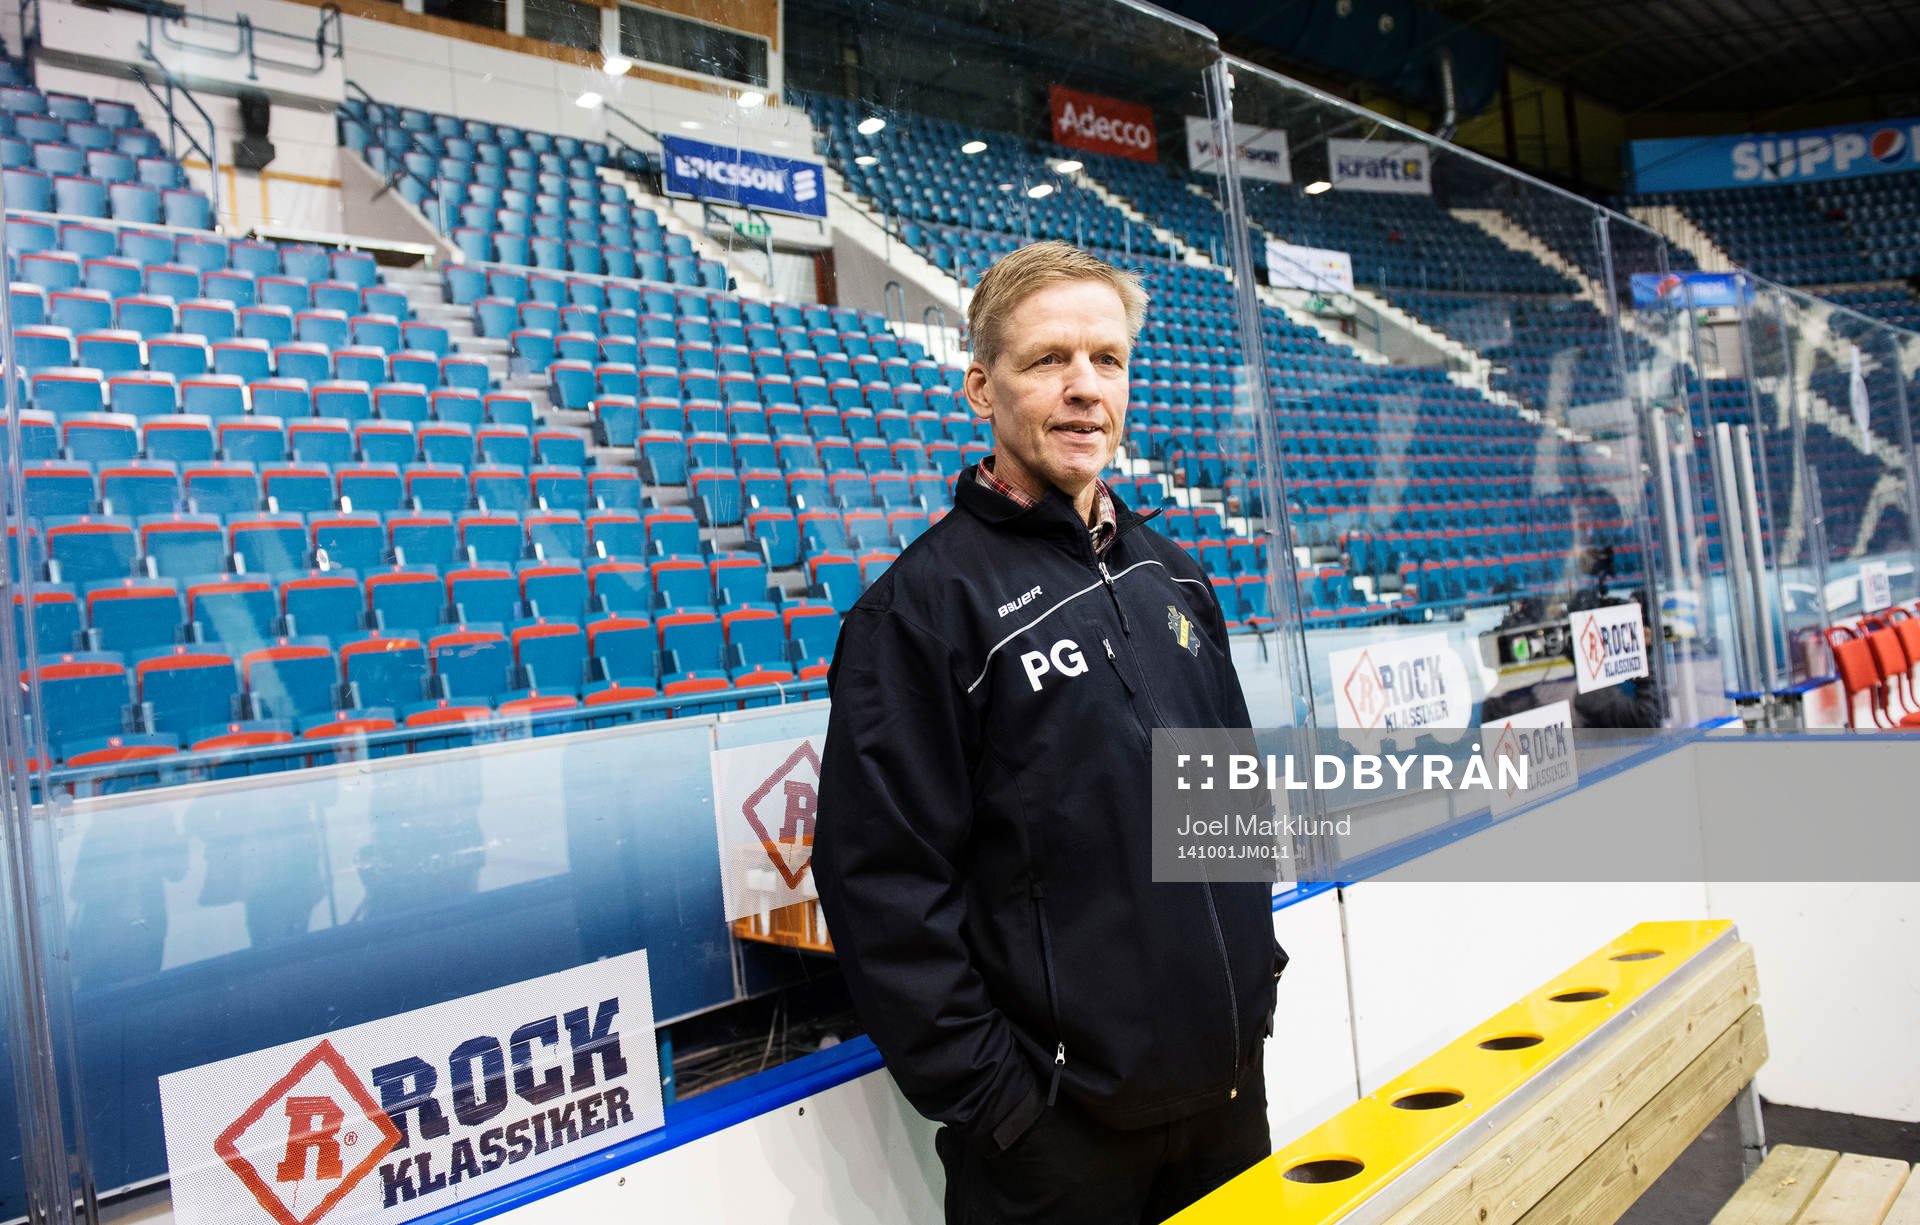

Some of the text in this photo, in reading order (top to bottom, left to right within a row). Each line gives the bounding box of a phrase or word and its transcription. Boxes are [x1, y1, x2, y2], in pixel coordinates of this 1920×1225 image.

[1058, 101, 1151, 149] Adecco
[674, 154, 785, 194] ERICSSON
[1600, 621, 1640, 657] ROCK
[1020, 638, 1090, 692] PG
[1379, 655, 1446, 708] ROCK
[1384, 700, 1450, 734] KLASSIKER
[1519, 722, 1567, 768] ROCK
[371, 997, 628, 1154] ROCK
[379, 1086, 634, 1209] KLASSIKER
